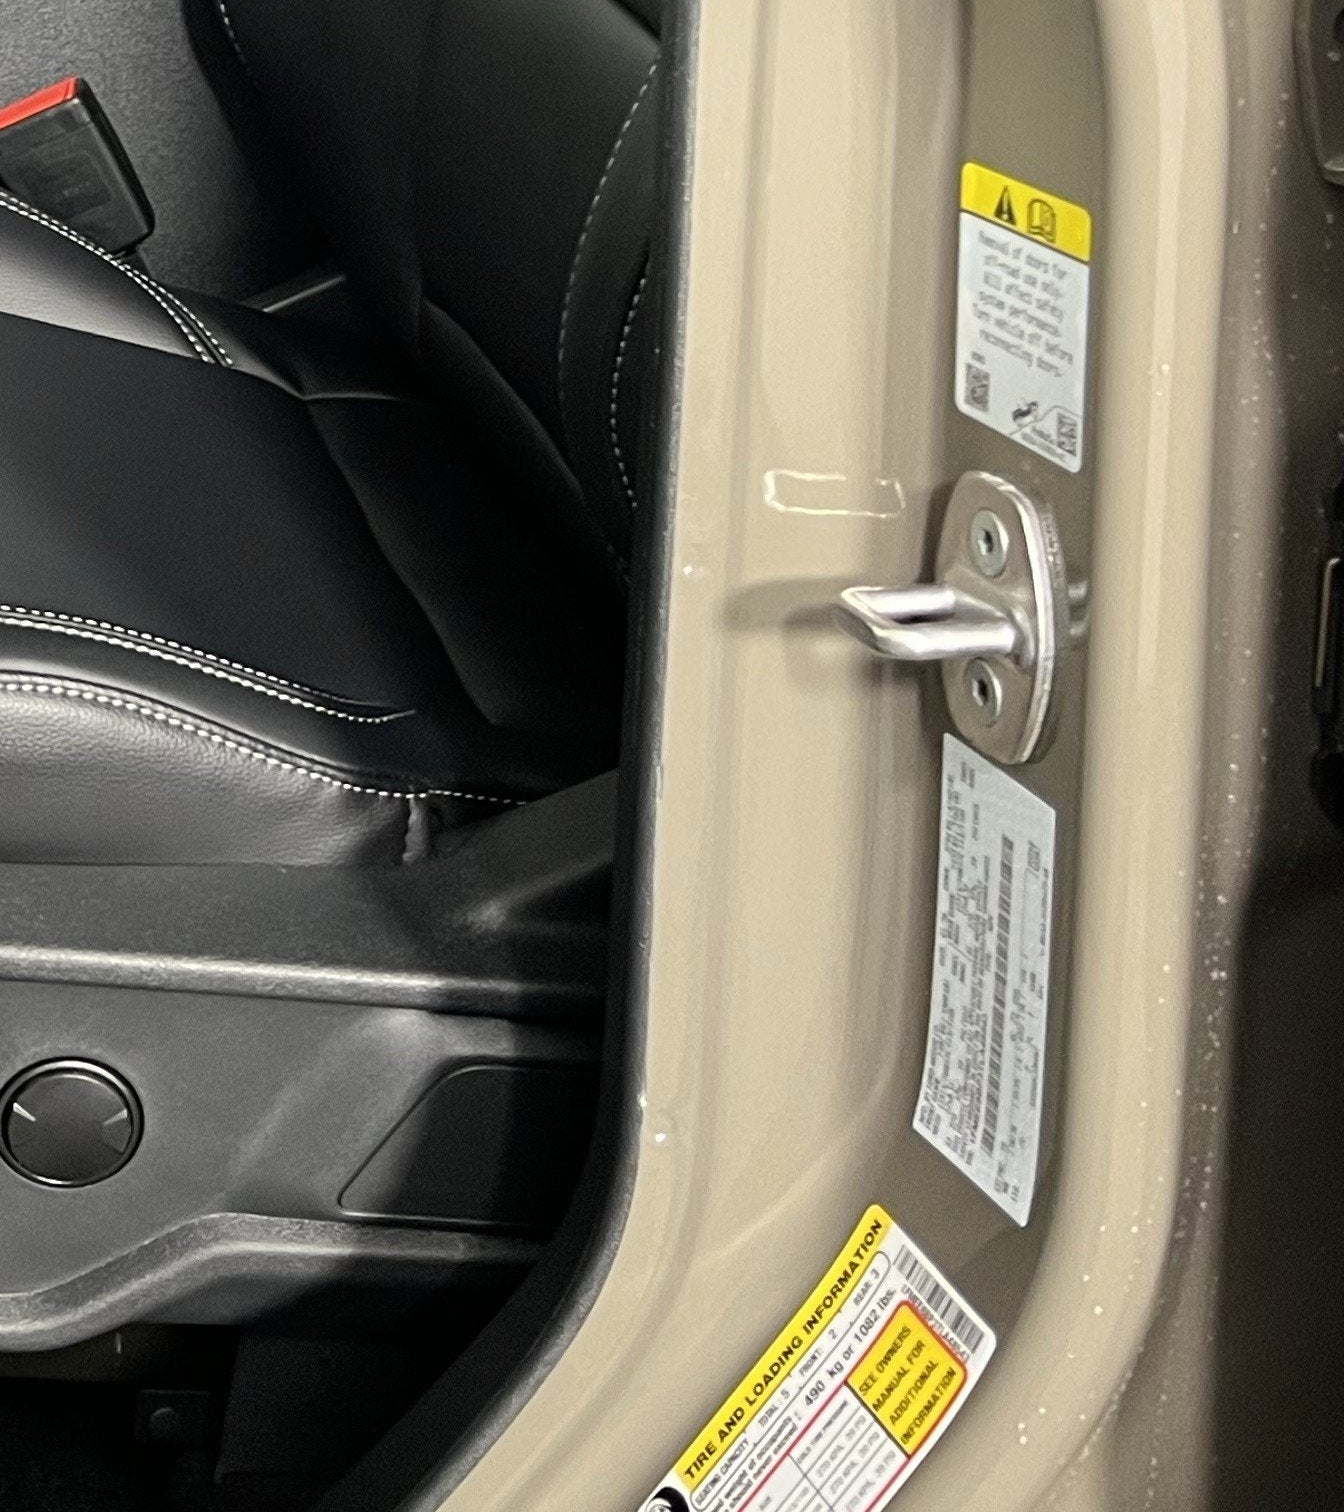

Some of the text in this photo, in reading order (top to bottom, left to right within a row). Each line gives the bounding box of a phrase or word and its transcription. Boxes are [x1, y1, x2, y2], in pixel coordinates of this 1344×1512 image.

[683, 1218, 883, 1479] TIRE AND LOADING INFORMATION
[805, 1380, 825, 1406] 490
[827, 1361, 844, 1378] kg
[842, 1345, 854, 1360] or
[854, 1309, 880, 1342] 1082
[859, 1372, 879, 1396] SEE
[872, 1339, 926, 1412] MANUAL FOR
[889, 1360, 939, 1426] ADDITIONAL
[900, 1366, 957, 1445] INFORMATION
